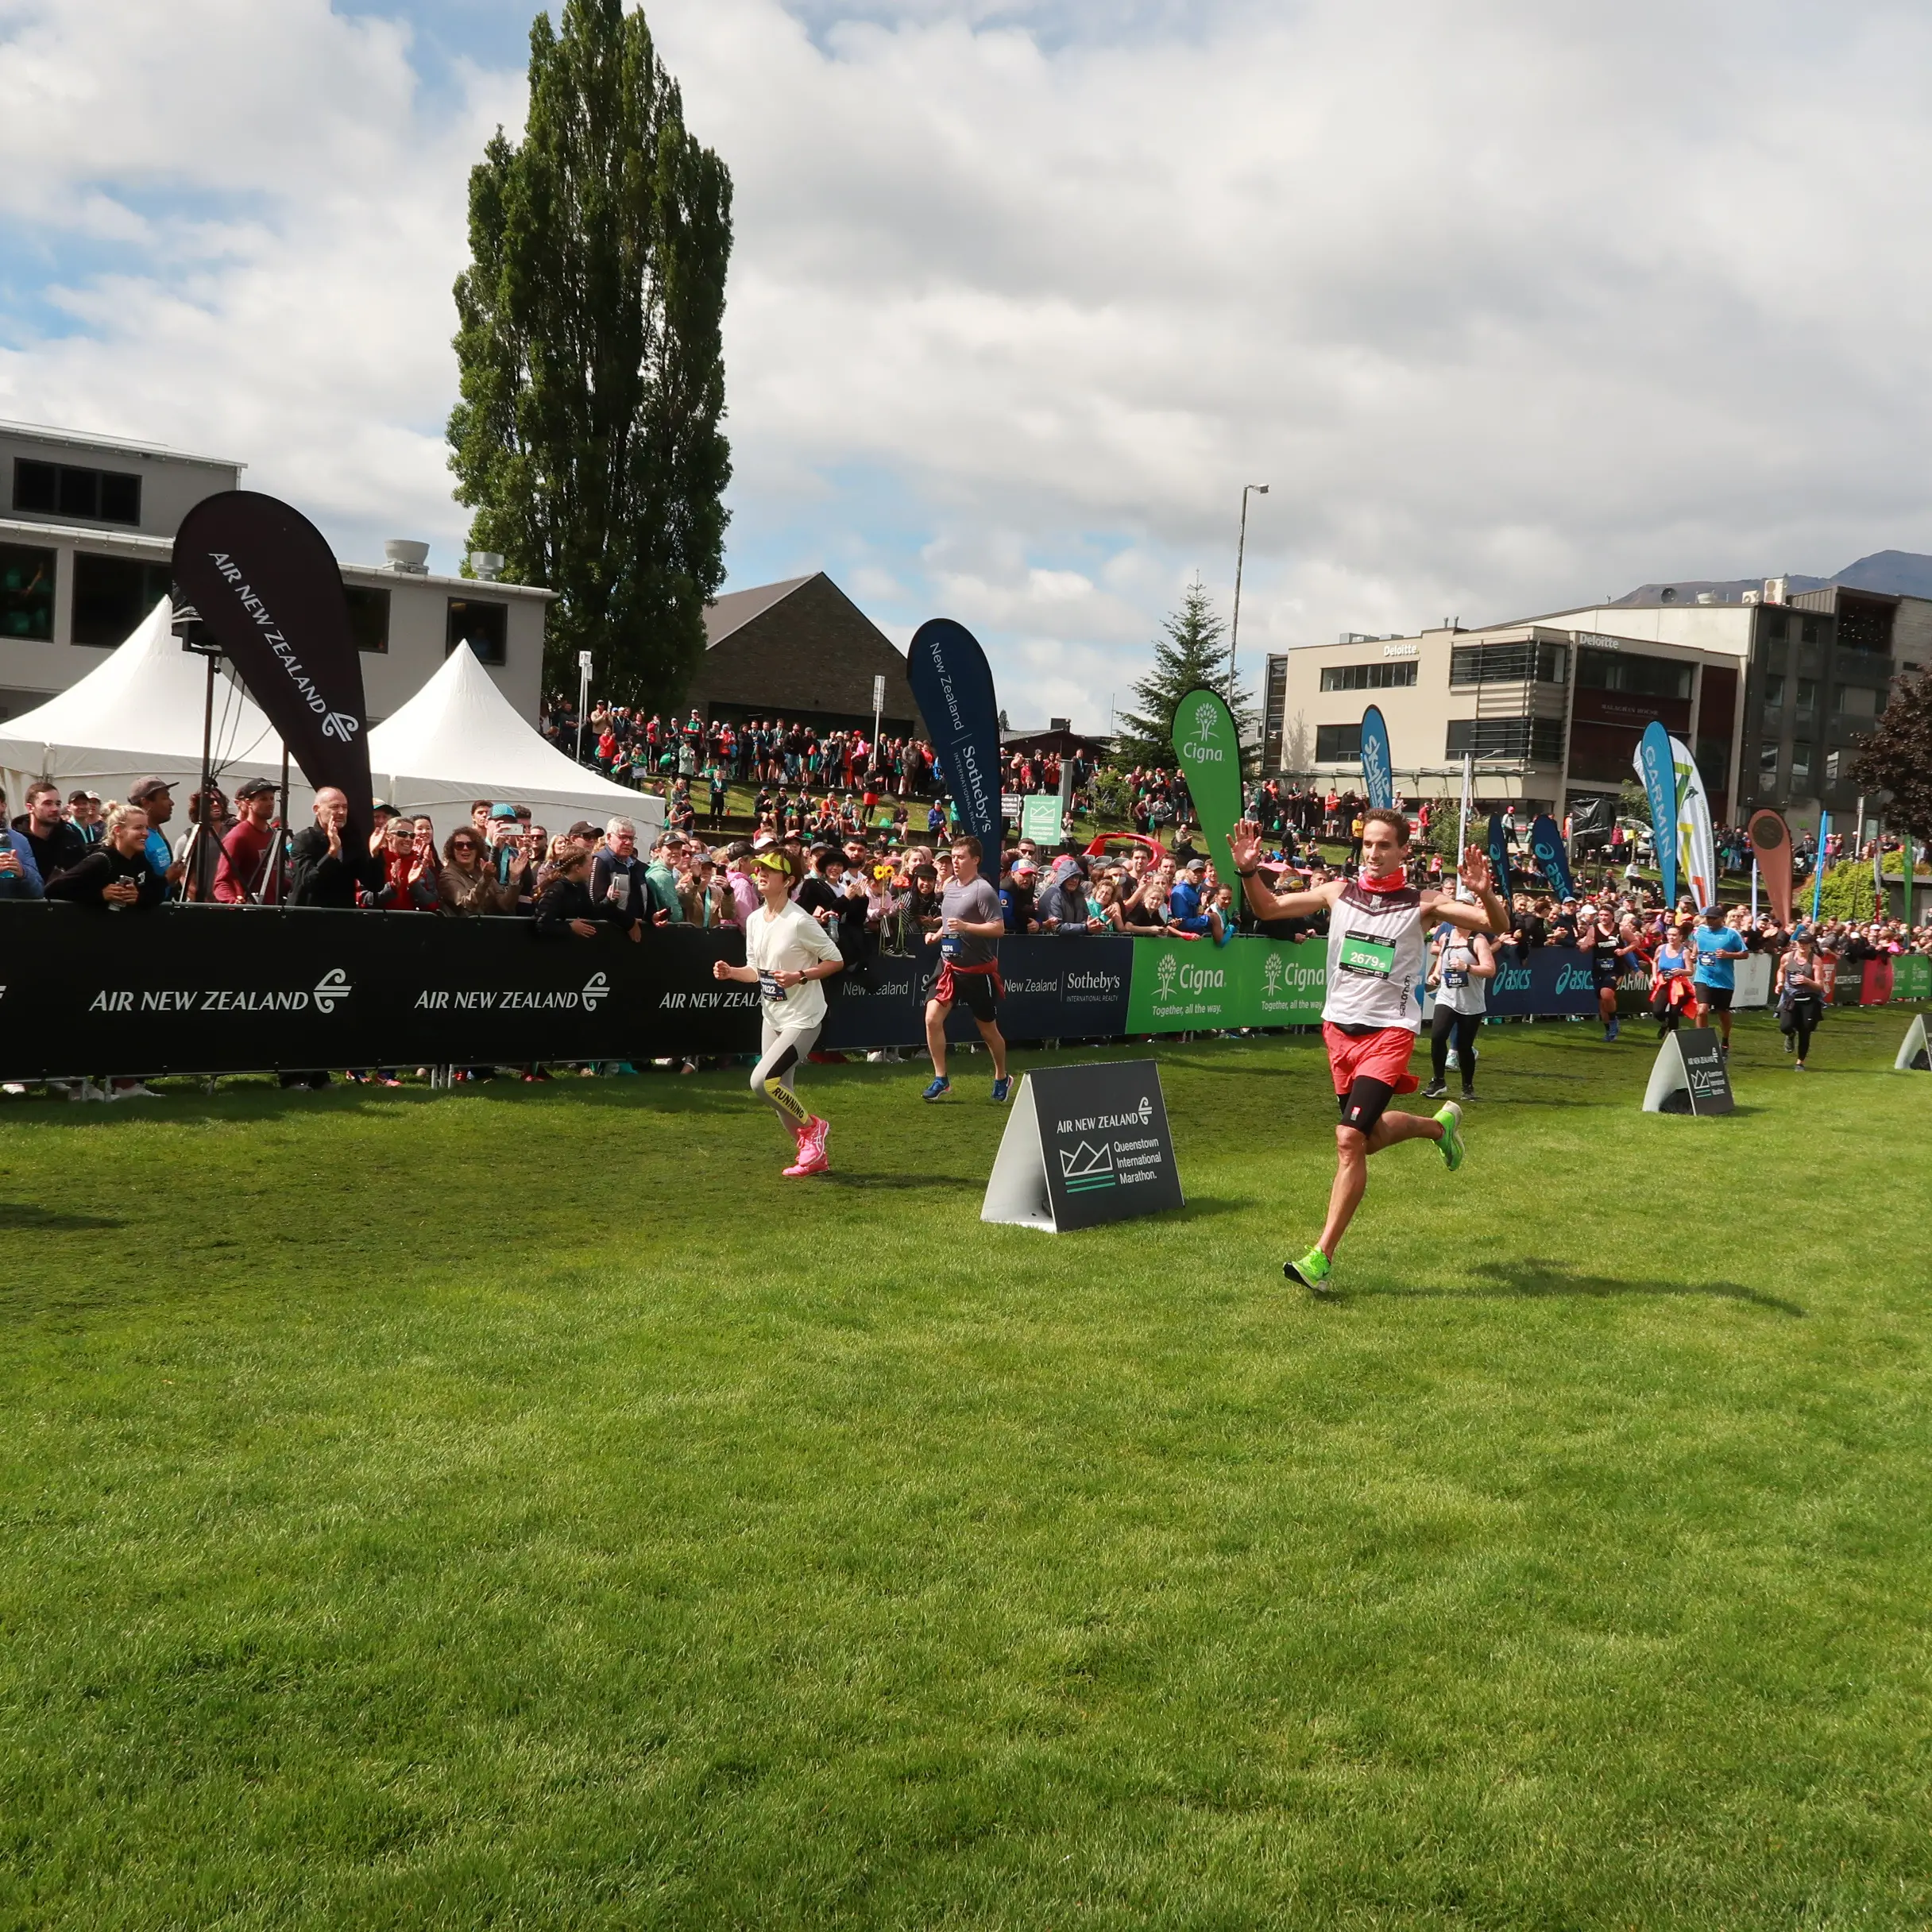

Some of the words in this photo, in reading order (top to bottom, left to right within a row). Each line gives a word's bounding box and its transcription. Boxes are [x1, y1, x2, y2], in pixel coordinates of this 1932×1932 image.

[207, 552, 242, 583] AIR
[234, 585, 274, 625] NEW
[264, 629, 327, 713] ZEALAND
[930, 642, 945, 673] New
[940, 674, 964, 731] Zealand
[1183, 742, 1223, 763] Cigna
[953, 752, 973, 811] INTERNATIONAL
[963, 745, 991, 833] Sotheby's
[1644, 745, 1672, 859] GARMIN
[1350, 952, 1379, 967] 2679
[1003, 978, 1023, 992] New
[1026, 978, 1057, 992] Zealand
[1067, 971, 1120, 992] Sotheby's
[1180, 964, 1224, 995] Cigna
[1285, 963, 1325, 991] Cigna
[843, 981, 866, 996] New
[88, 990, 134, 1011] AIR
[141, 991, 198, 1010] NEW
[200, 991, 309, 1010] ZEALAND
[414, 990, 450, 1009] AIR
[454, 991, 497, 1009] NEW
[499, 991, 578, 1008] ZEALAND
[659, 992, 686, 1009] AIR
[689, 992, 722, 1008] NEW
[1153, 1005, 1184, 1017] Together,
[1194, 1003, 1205, 1014] the
[1207, 1004, 1221, 1015] way.
[1262, 1000, 1289, 1011] Together,
[1298, 999, 1309, 1009] the
[772, 1087, 804, 1119] RUNNING
[1057, 1120, 1072, 1134] AIR
[1075, 1117, 1096, 1132] NEW
[1098, 1112, 1138, 1129] ZEALAND
[1114, 1138, 1159, 1153] Queenstown
[1116, 1152, 1162, 1169] International
[1119, 1171, 1157, 1184] Marathon.
